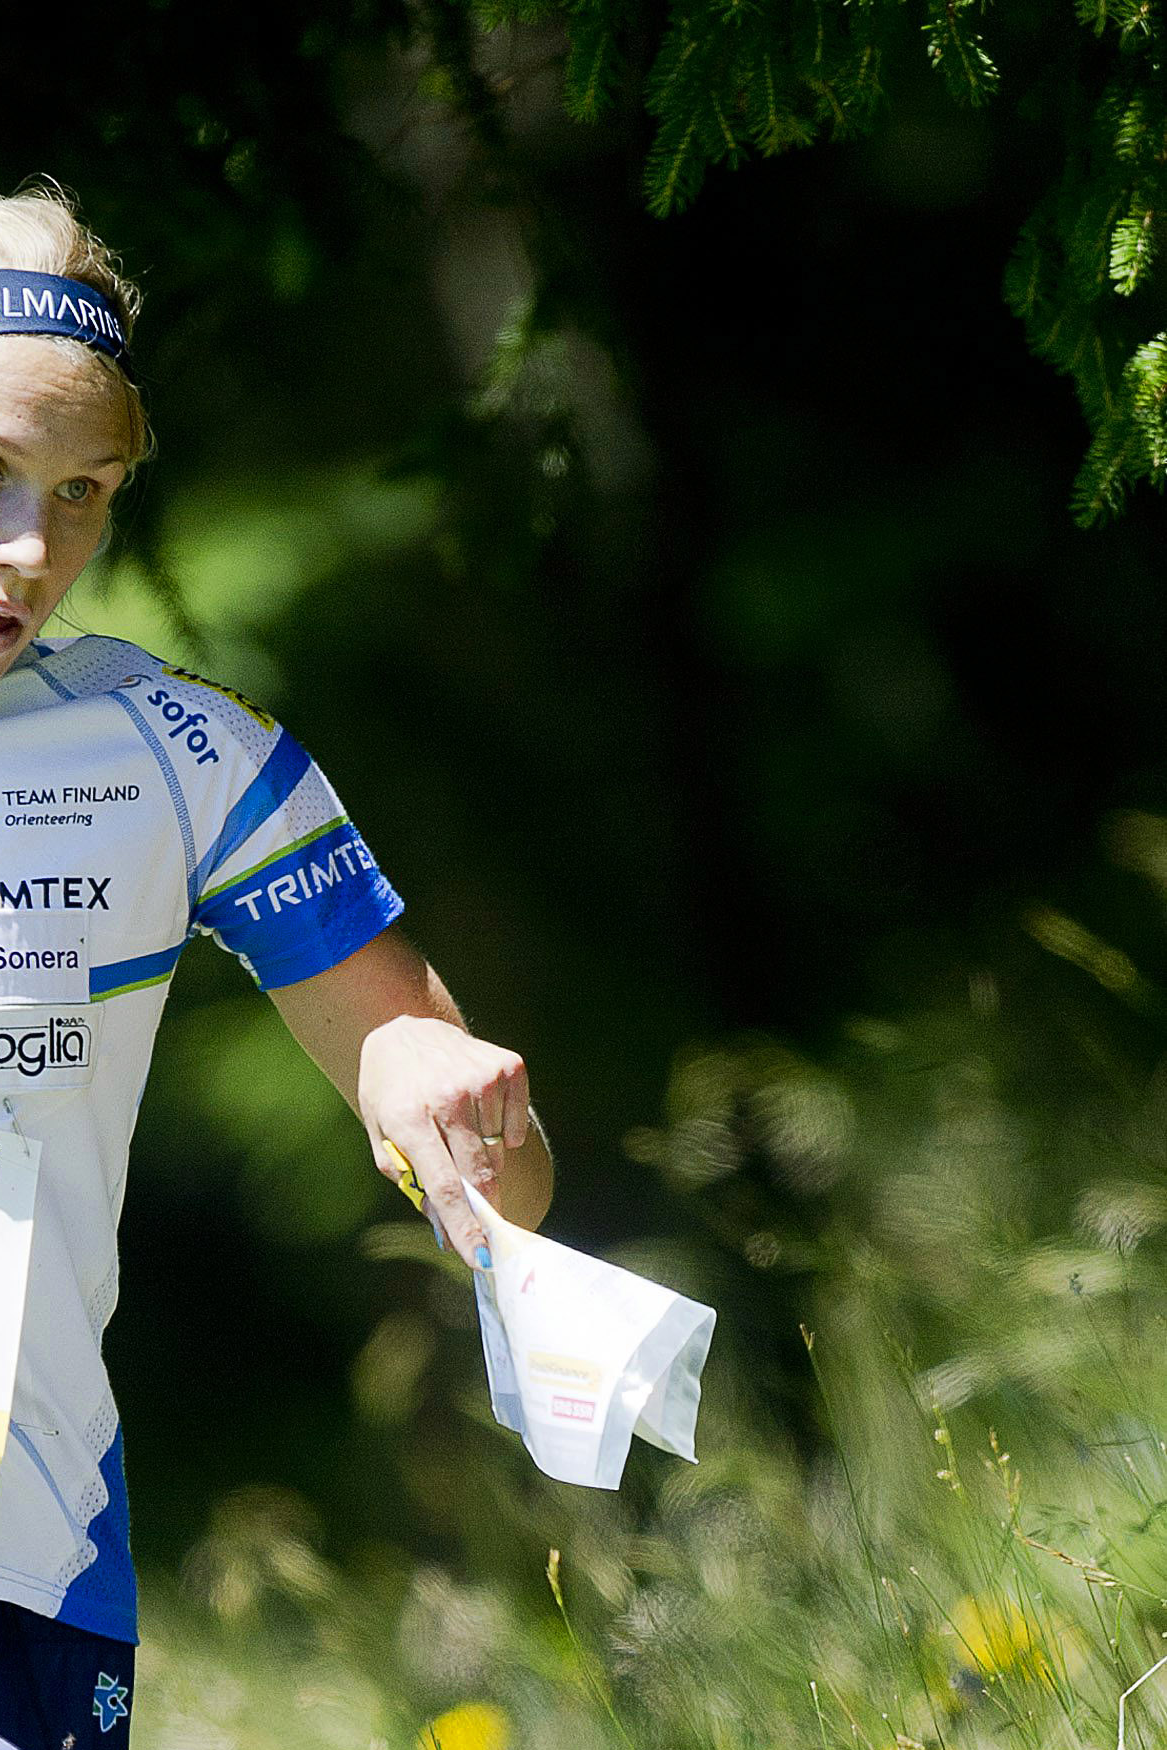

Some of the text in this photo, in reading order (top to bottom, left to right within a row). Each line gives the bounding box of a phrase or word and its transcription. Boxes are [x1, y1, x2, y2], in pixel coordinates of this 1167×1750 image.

[146, 690, 220, 765] sofor
[2, 785, 140, 806] TEAM FINLAND
[4, 812, 93, 827] Orienteering
